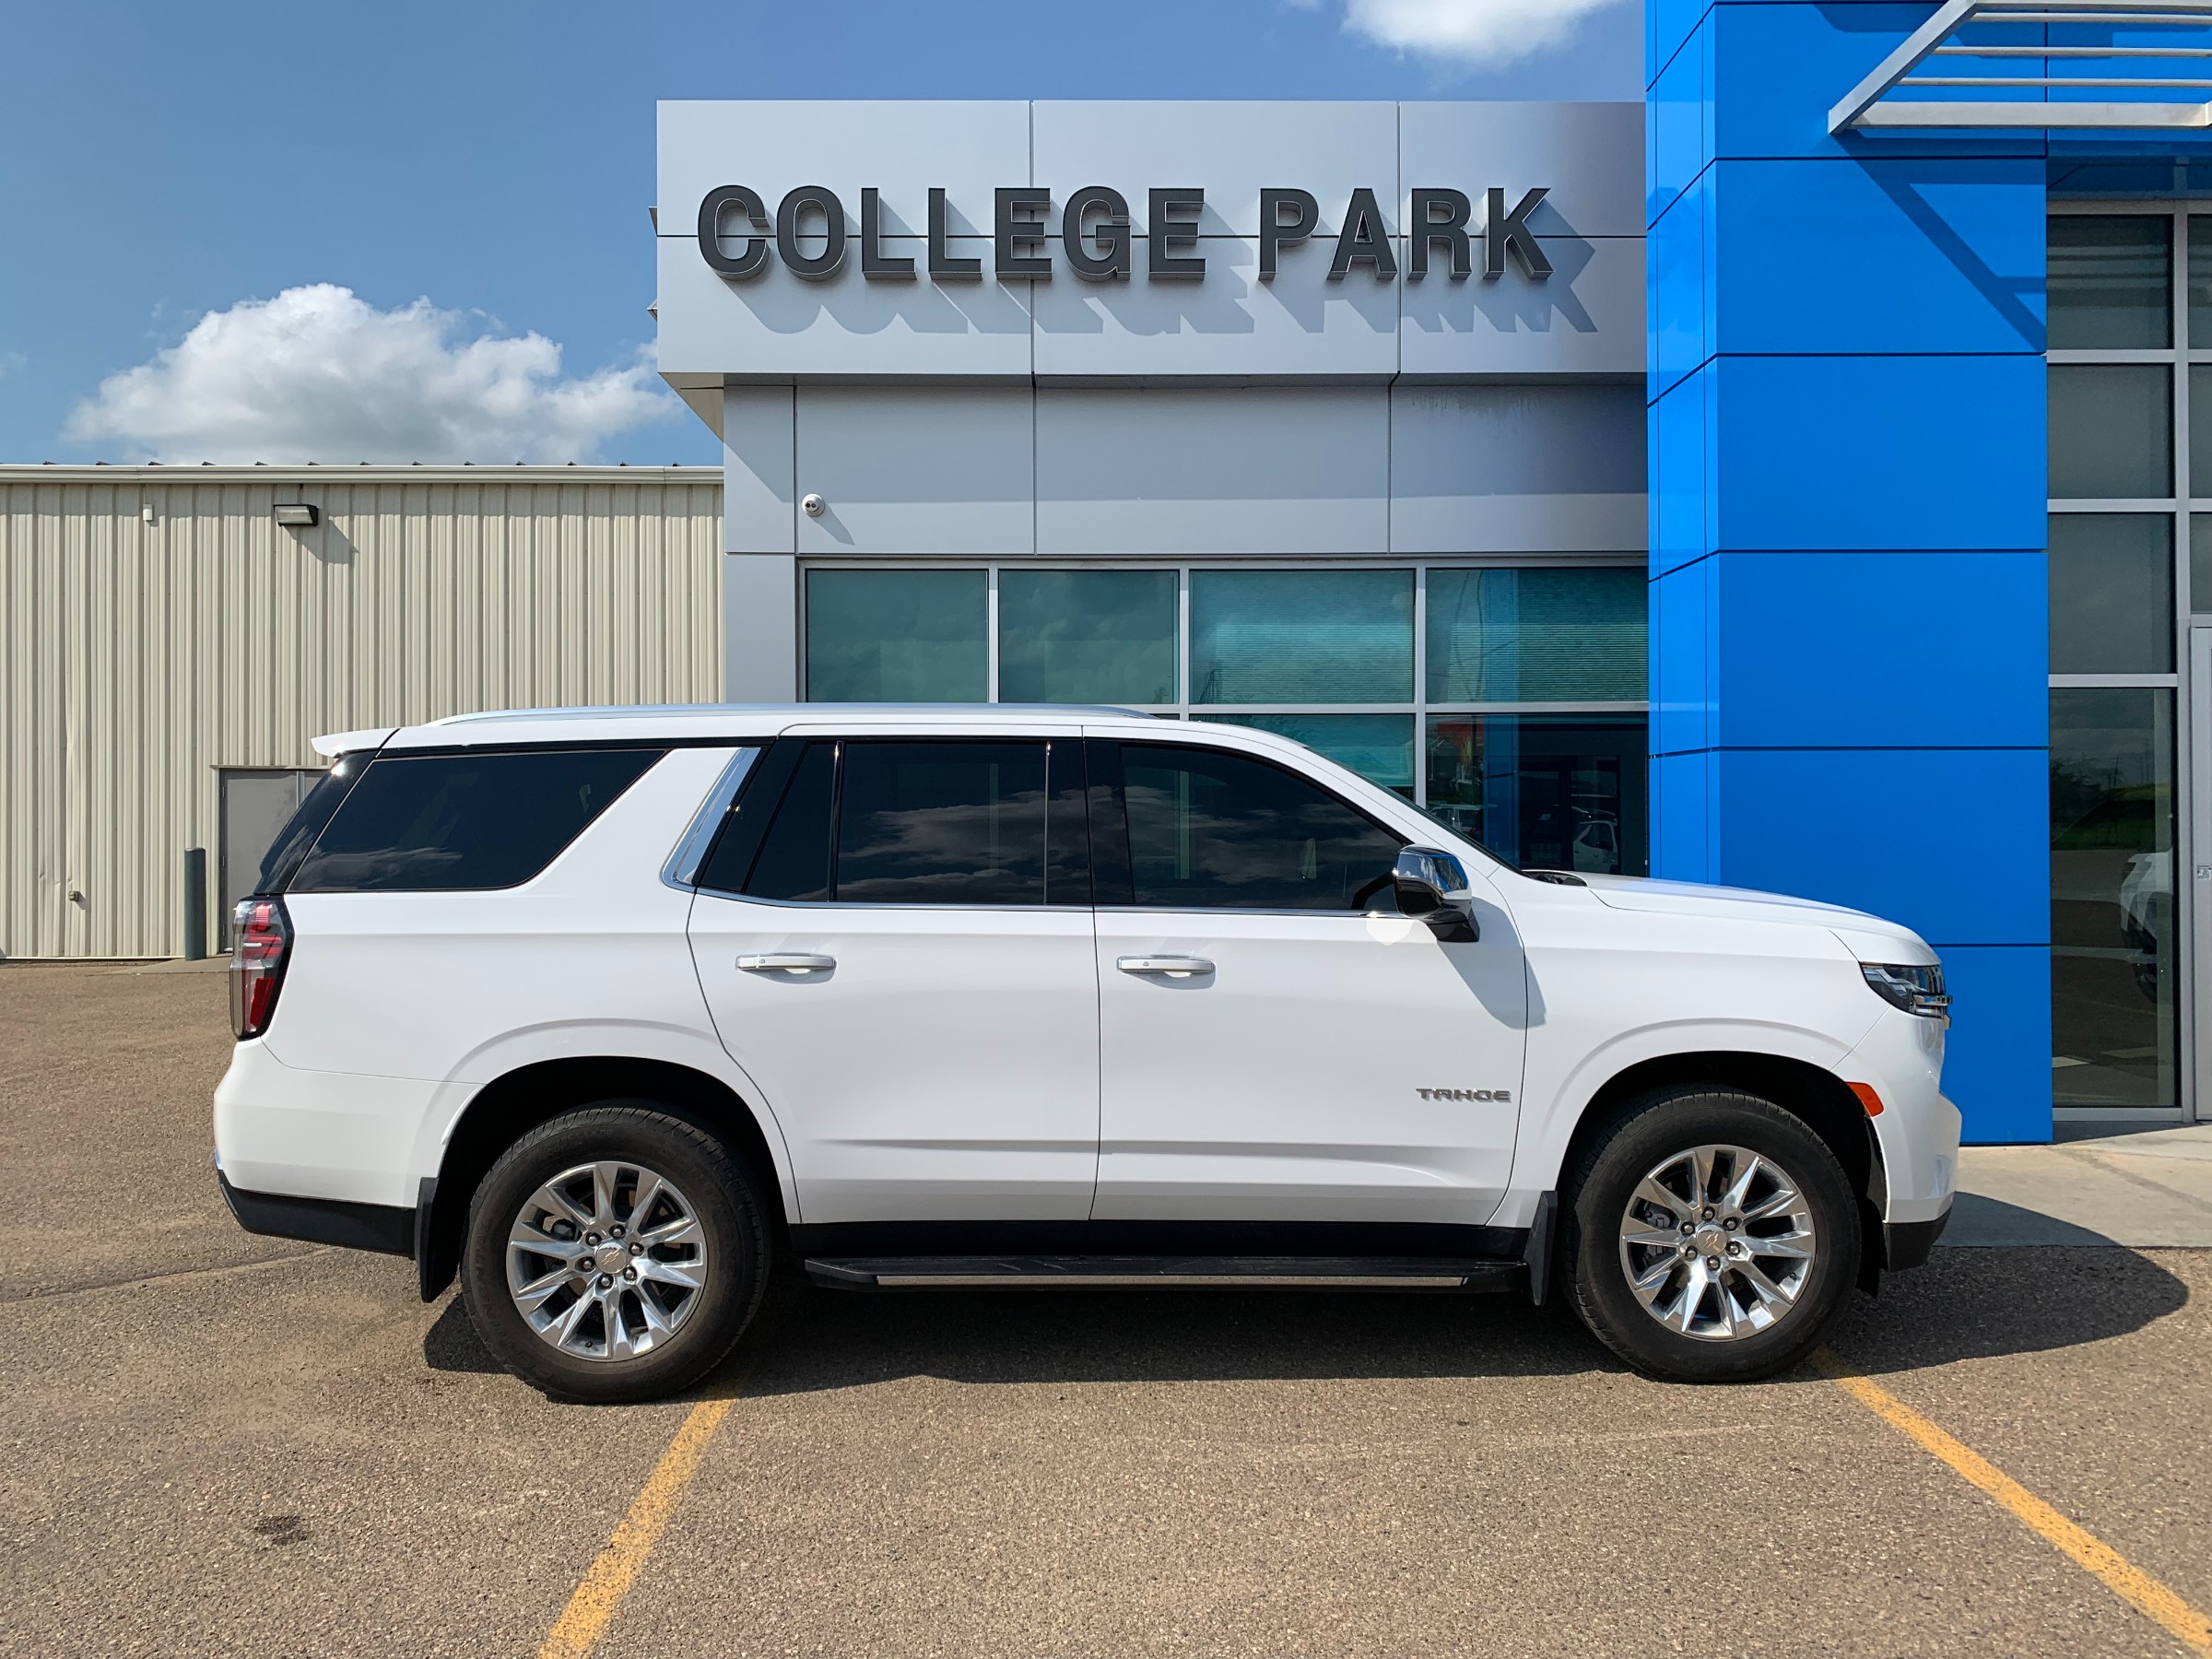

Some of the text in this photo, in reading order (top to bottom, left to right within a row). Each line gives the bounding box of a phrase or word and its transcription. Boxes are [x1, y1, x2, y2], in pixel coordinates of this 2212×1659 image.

[698, 184, 1555, 279] COLLEGE PARK
[1416, 1088, 1512, 1102] TAHOE
